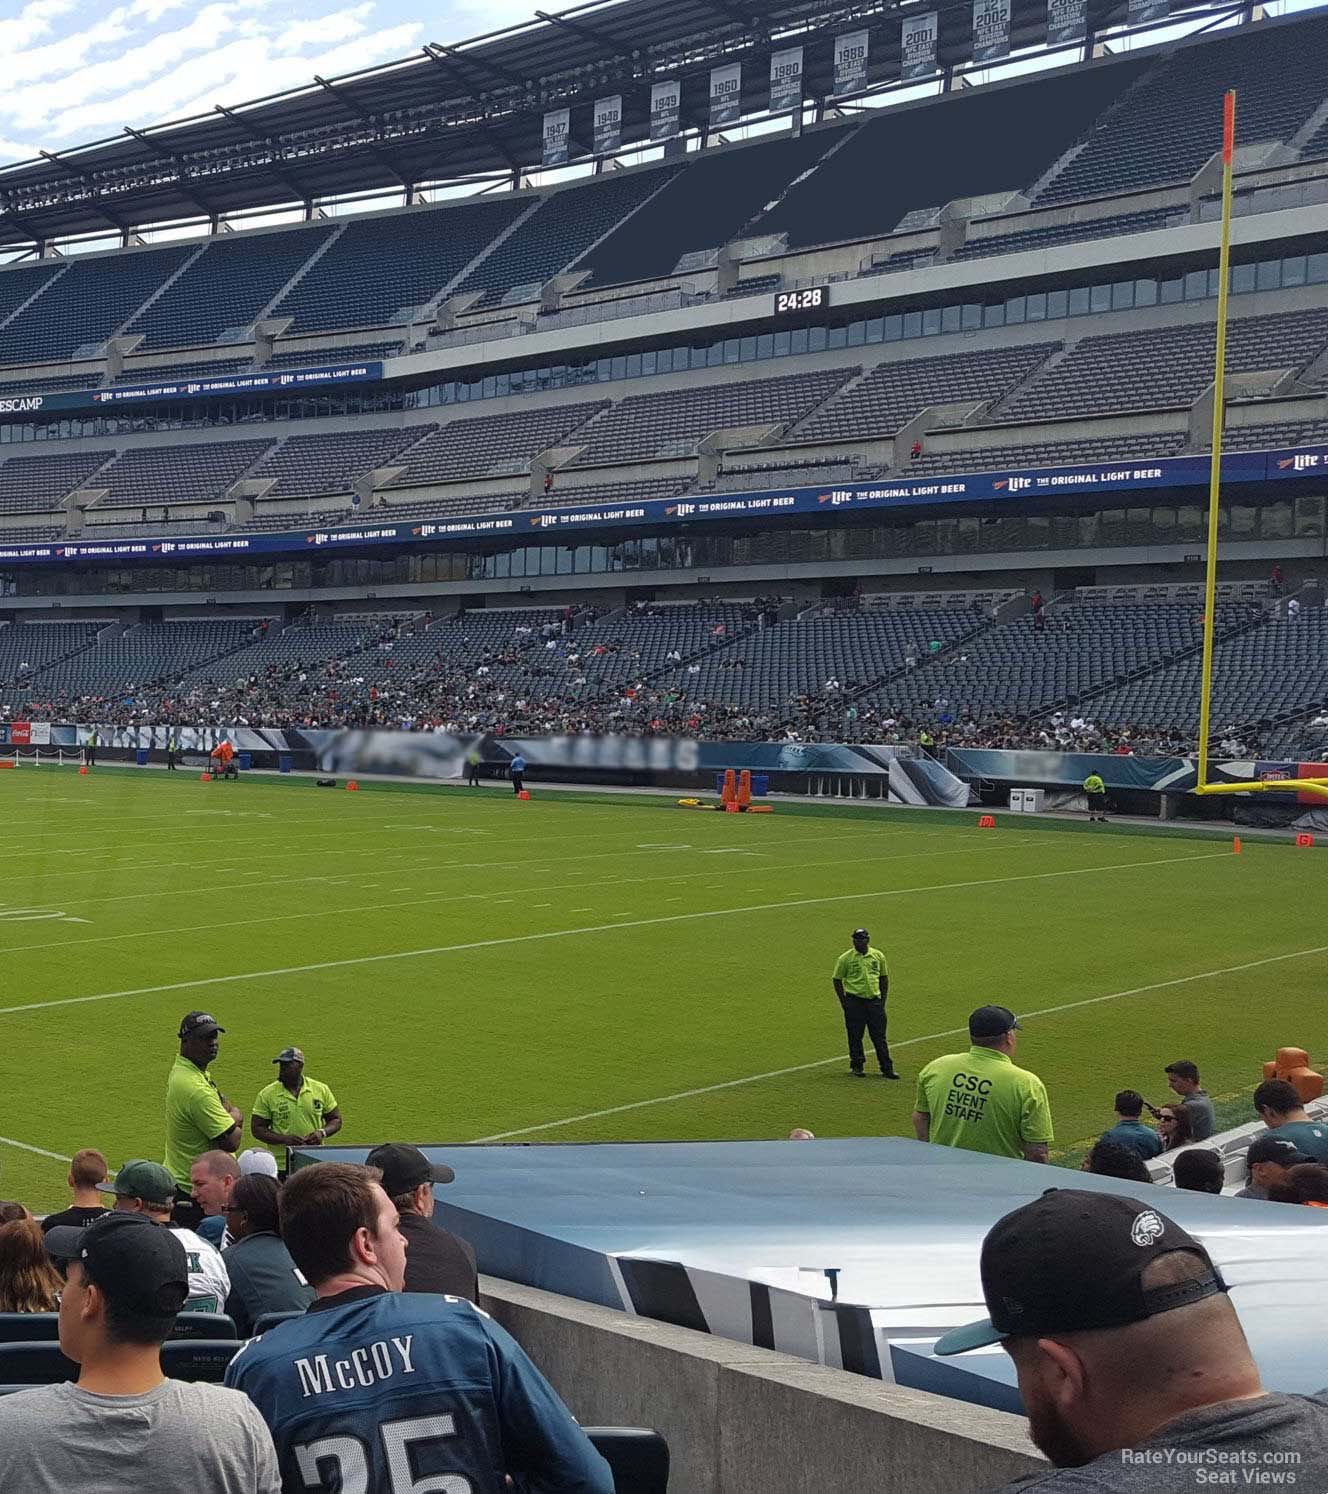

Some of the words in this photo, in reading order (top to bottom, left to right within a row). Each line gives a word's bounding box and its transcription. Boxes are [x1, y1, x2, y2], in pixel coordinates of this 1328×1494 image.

[976, 9, 1008, 27] 2002
[905, 28, 933, 46] 2001
[838, 46, 864, 63] 1988
[774, 62, 799, 79] 1980
[714, 79, 738, 95] 1960
[655, 95, 676, 111] 1949
[597, 110, 619, 125] 1948
[546, 122, 566, 137] 1947
[778, 289, 822, 312] 24:28
[1293, 455, 1319, 470] Lite
[1008, 477, 1032, 491] Lite
[1051, 473, 1098, 486] ORIGINAL
[1101, 471, 1131, 482] LIGHT
[1133, 469, 1162, 480] BEER
[831, 491, 853, 504] Lite
[869, 488, 911, 499] ORIGINAL
[912, 486, 939, 496] LIGHT
[941, 484, 965, 493] BEER
[677, 503, 695, 517] Lite
[710, 501, 747, 511] ORIGINAL
[747, 499, 771, 509] LIGHT
[773, 497, 795, 506] BEER
[447, 522, 476, 532] ORIGINAL
[477, 520, 495, 530] LIGHT
[495, 519, 513, 528] BEER
[541, 515, 557, 527] Lite
[570, 512, 602, 523] ORIGINAL
[603, 511, 625, 521] LIGHT
[626, 509, 645, 517] BEER
[338, 532, 364, 541] ORIGINAL
[364, 531, 380, 539] LIGHT
[381, 529, 396, 537] BEER
[186, 541, 213, 550] ORIGINAL
[214, 541, 232, 549] LIGHT
[1299, 835, 1309, 845] G
[953, 1073, 993, 1096] CSC
[948, 1089, 987, 1110] EVENT
[945, 1103, 985, 1123] STAFF
[294, 1335, 416, 1397] McCOY
